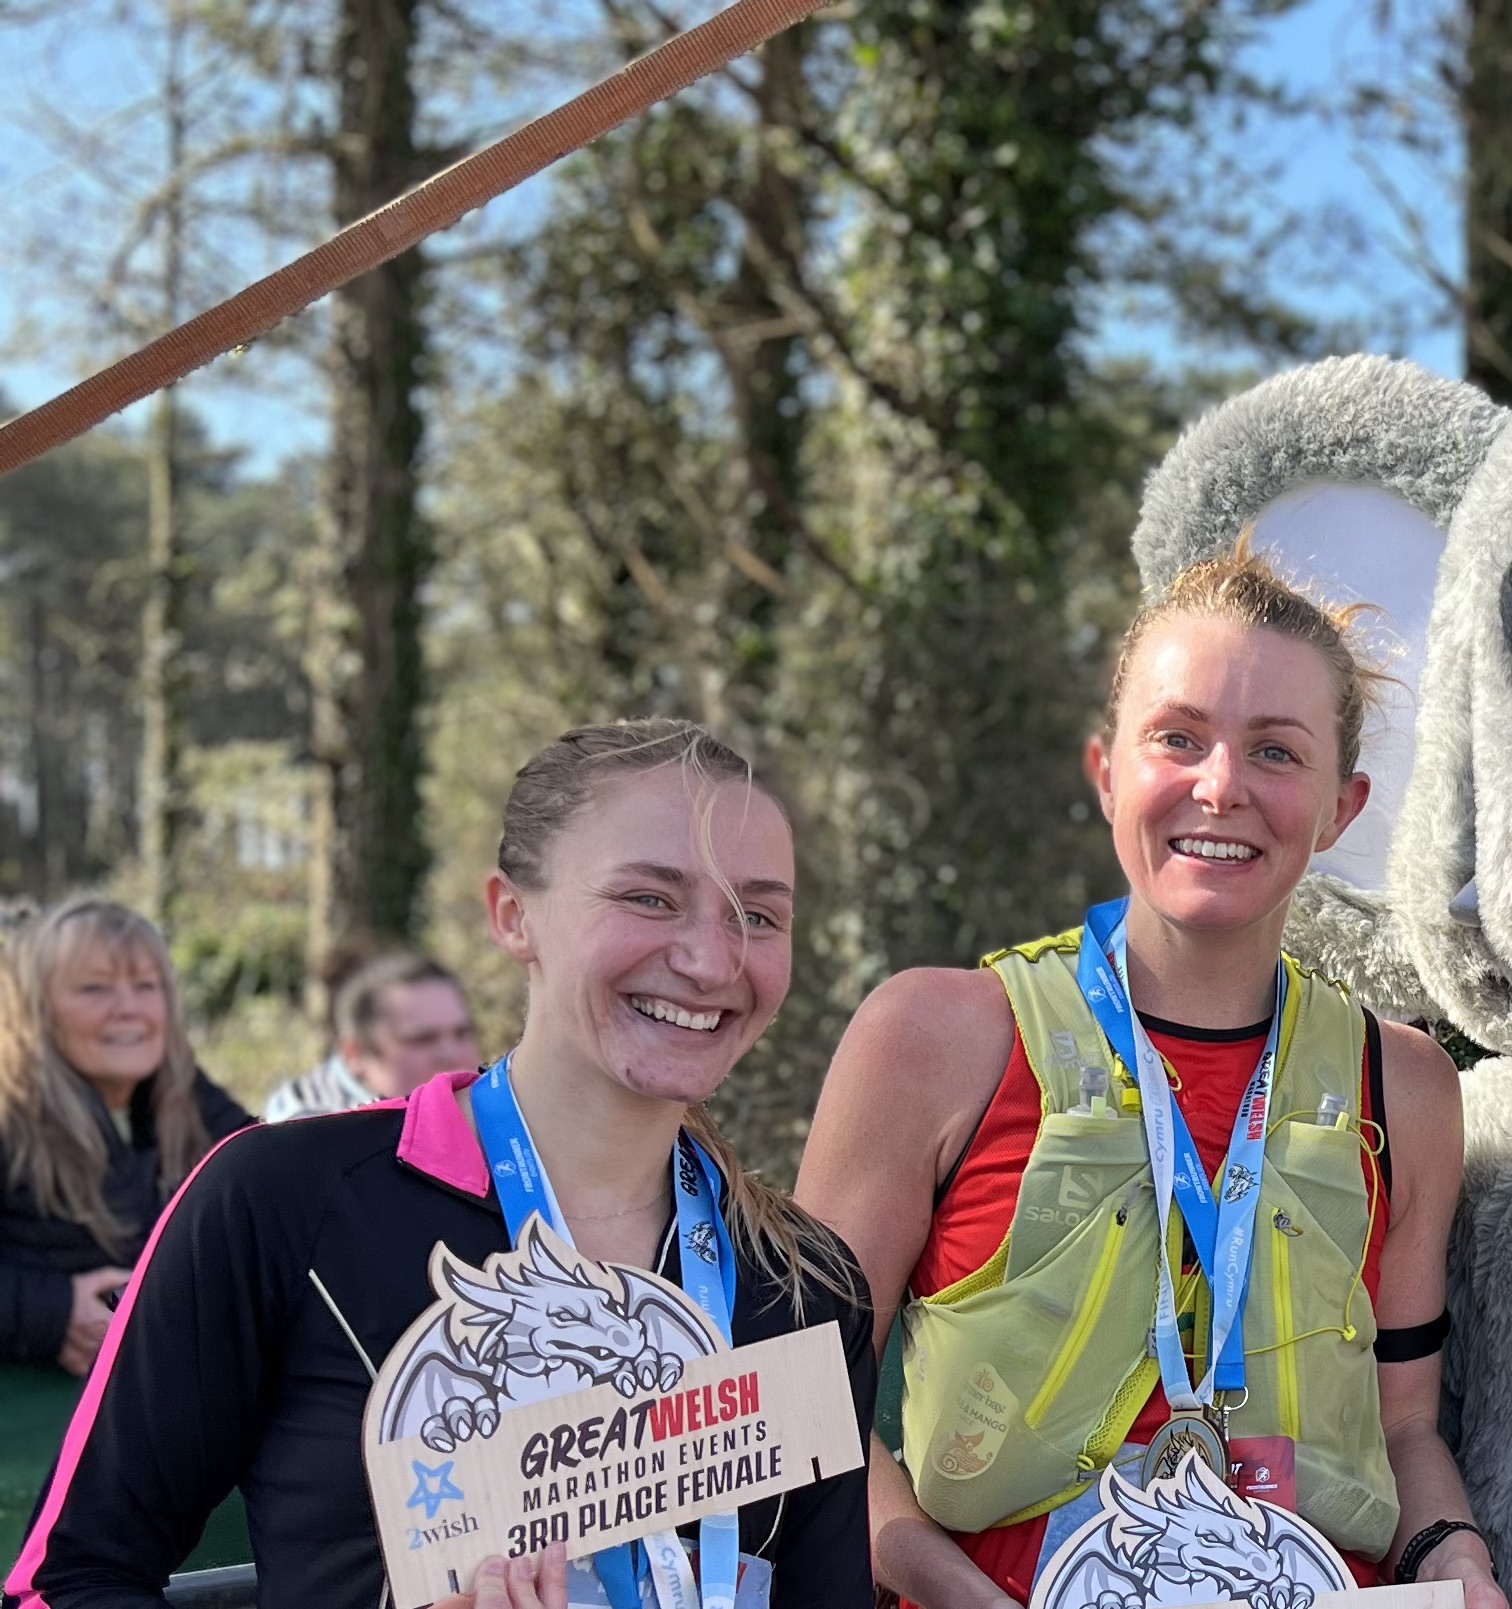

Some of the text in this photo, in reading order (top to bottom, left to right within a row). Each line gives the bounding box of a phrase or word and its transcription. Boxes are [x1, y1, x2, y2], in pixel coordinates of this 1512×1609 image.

[1226, 1226, 1245, 1308] #RunCymru
[970, 1408, 1007, 1433] MANGO
[507, 1445, 783, 1560] 3RD PLACE FEMALE
[521, 1420, 768, 1513] MARATHON EVENTS
[406, 1512, 479, 1551] 2wish
